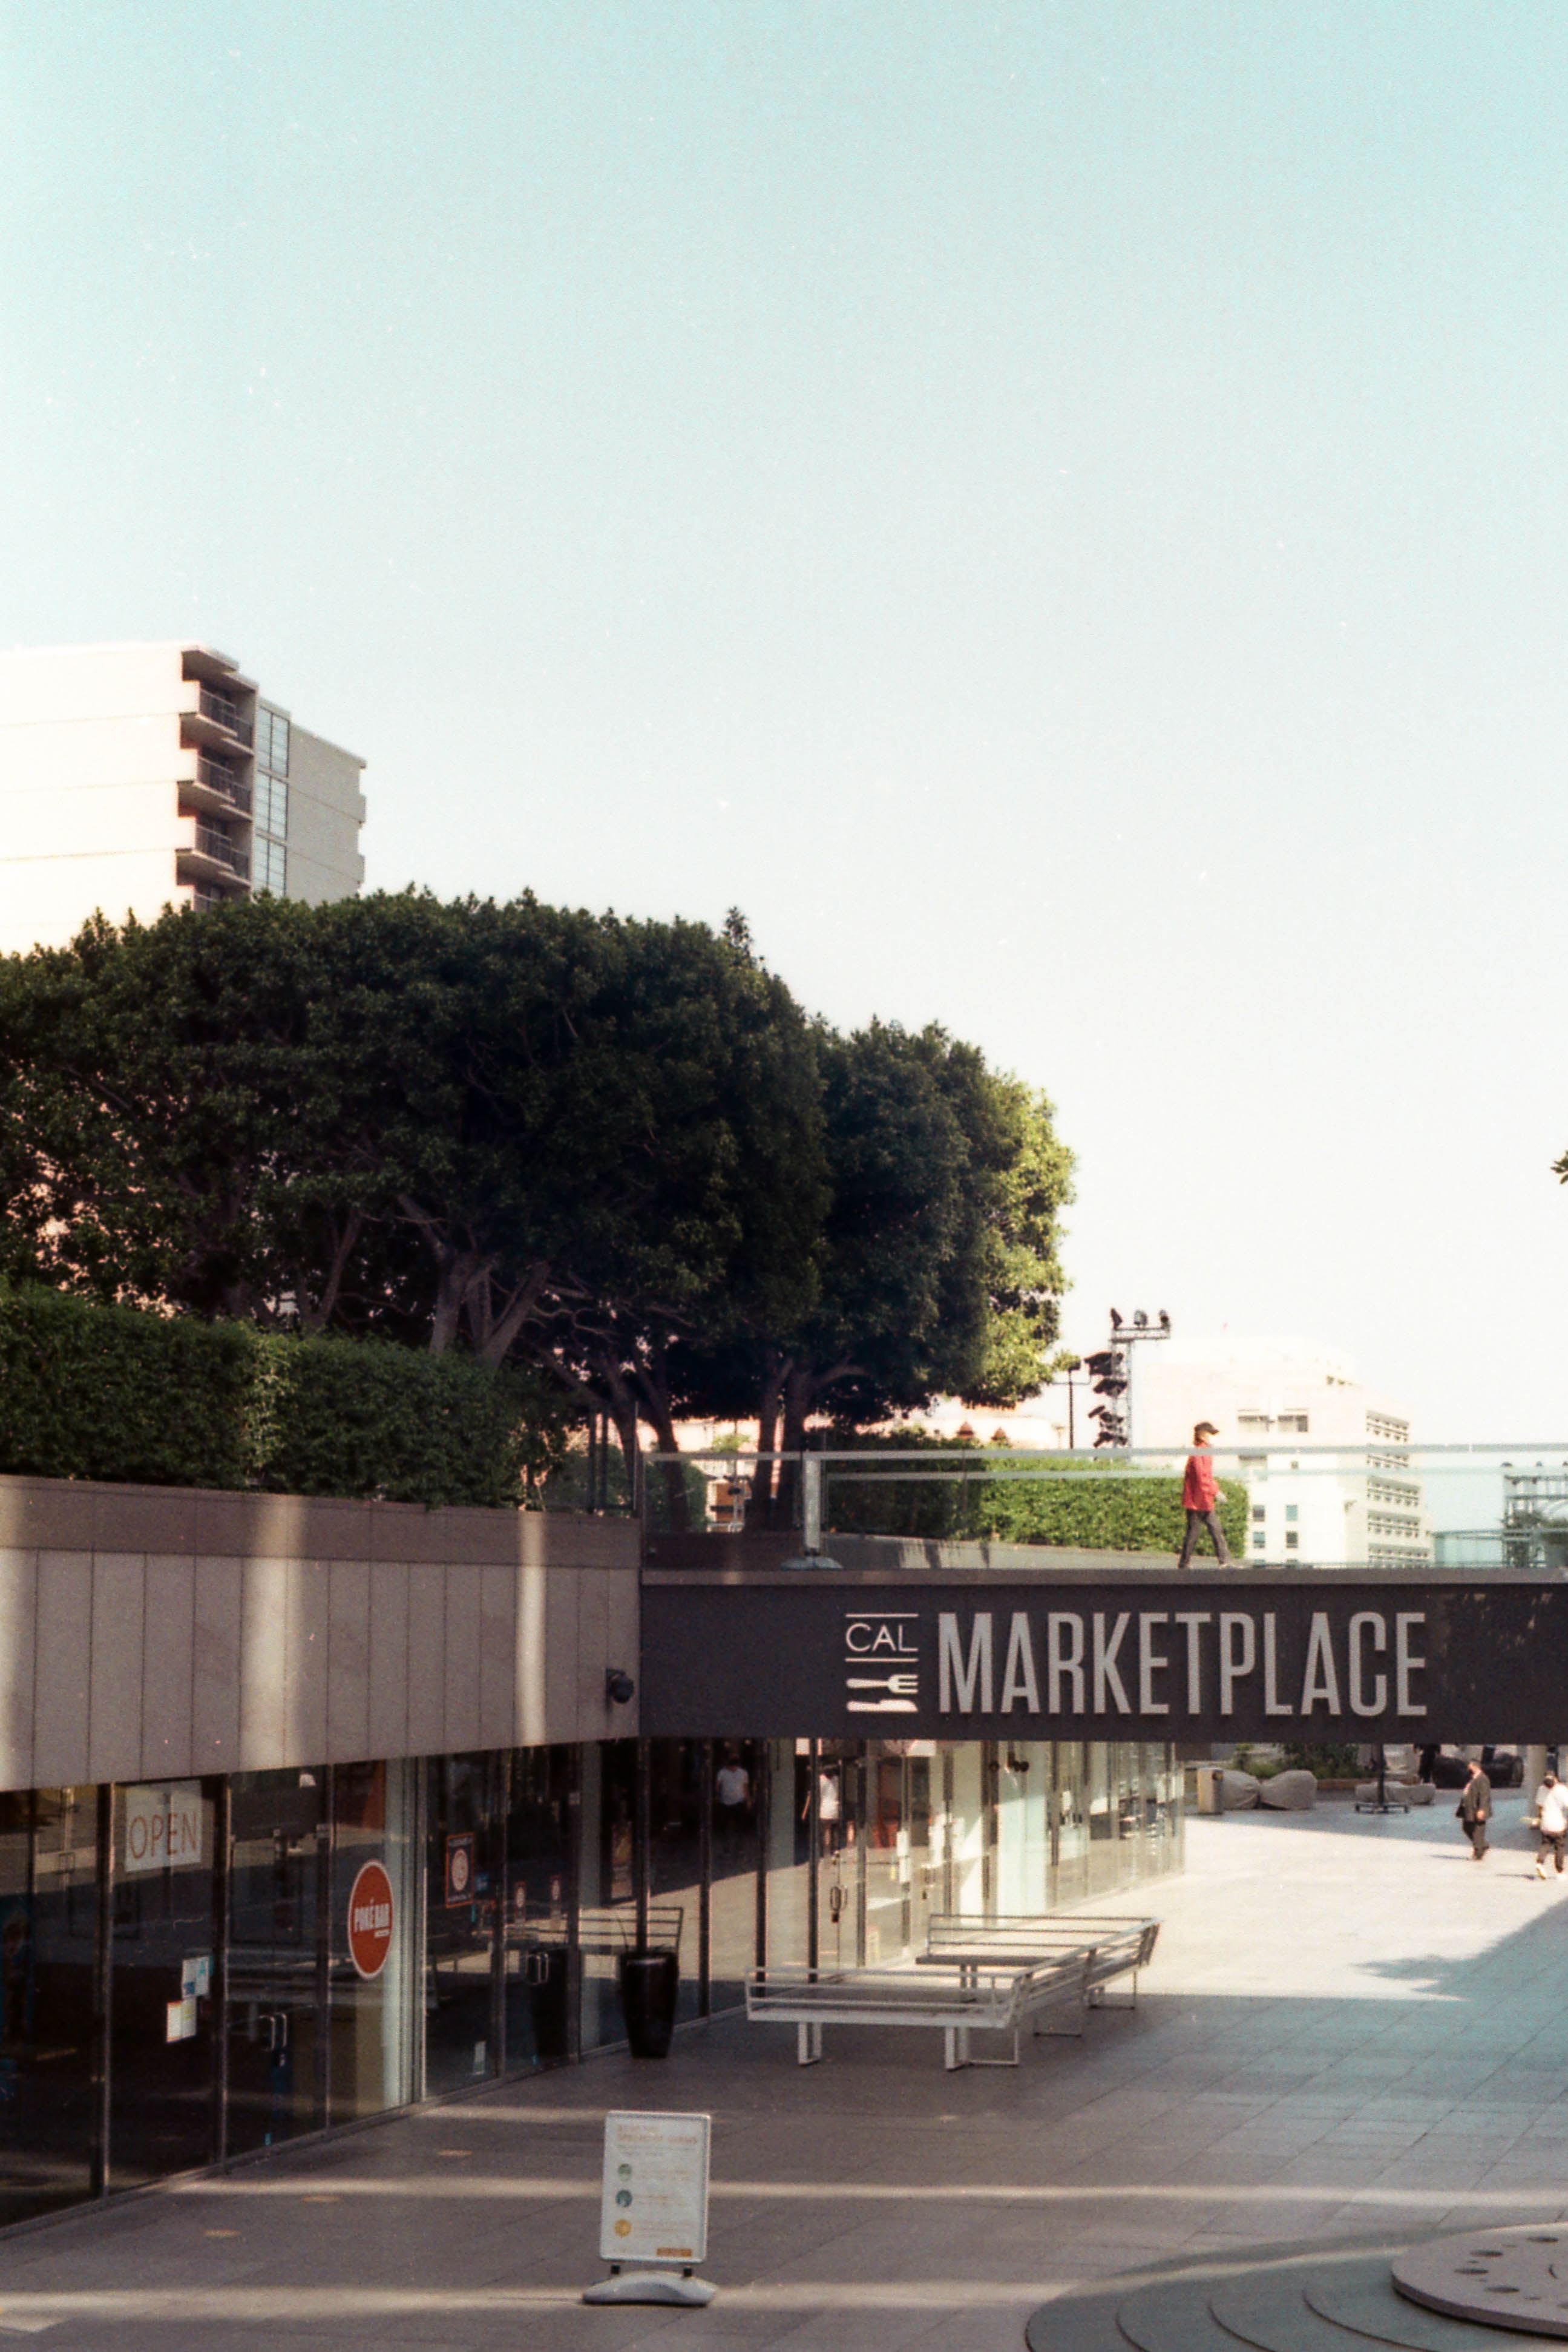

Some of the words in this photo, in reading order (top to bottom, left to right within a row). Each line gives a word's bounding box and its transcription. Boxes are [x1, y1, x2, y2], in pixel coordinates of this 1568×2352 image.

[845, 1623, 919, 1652] CAL
[939, 1612, 1428, 1716] MARKETPLACE
[130, 1811, 197, 1859] OPEN
